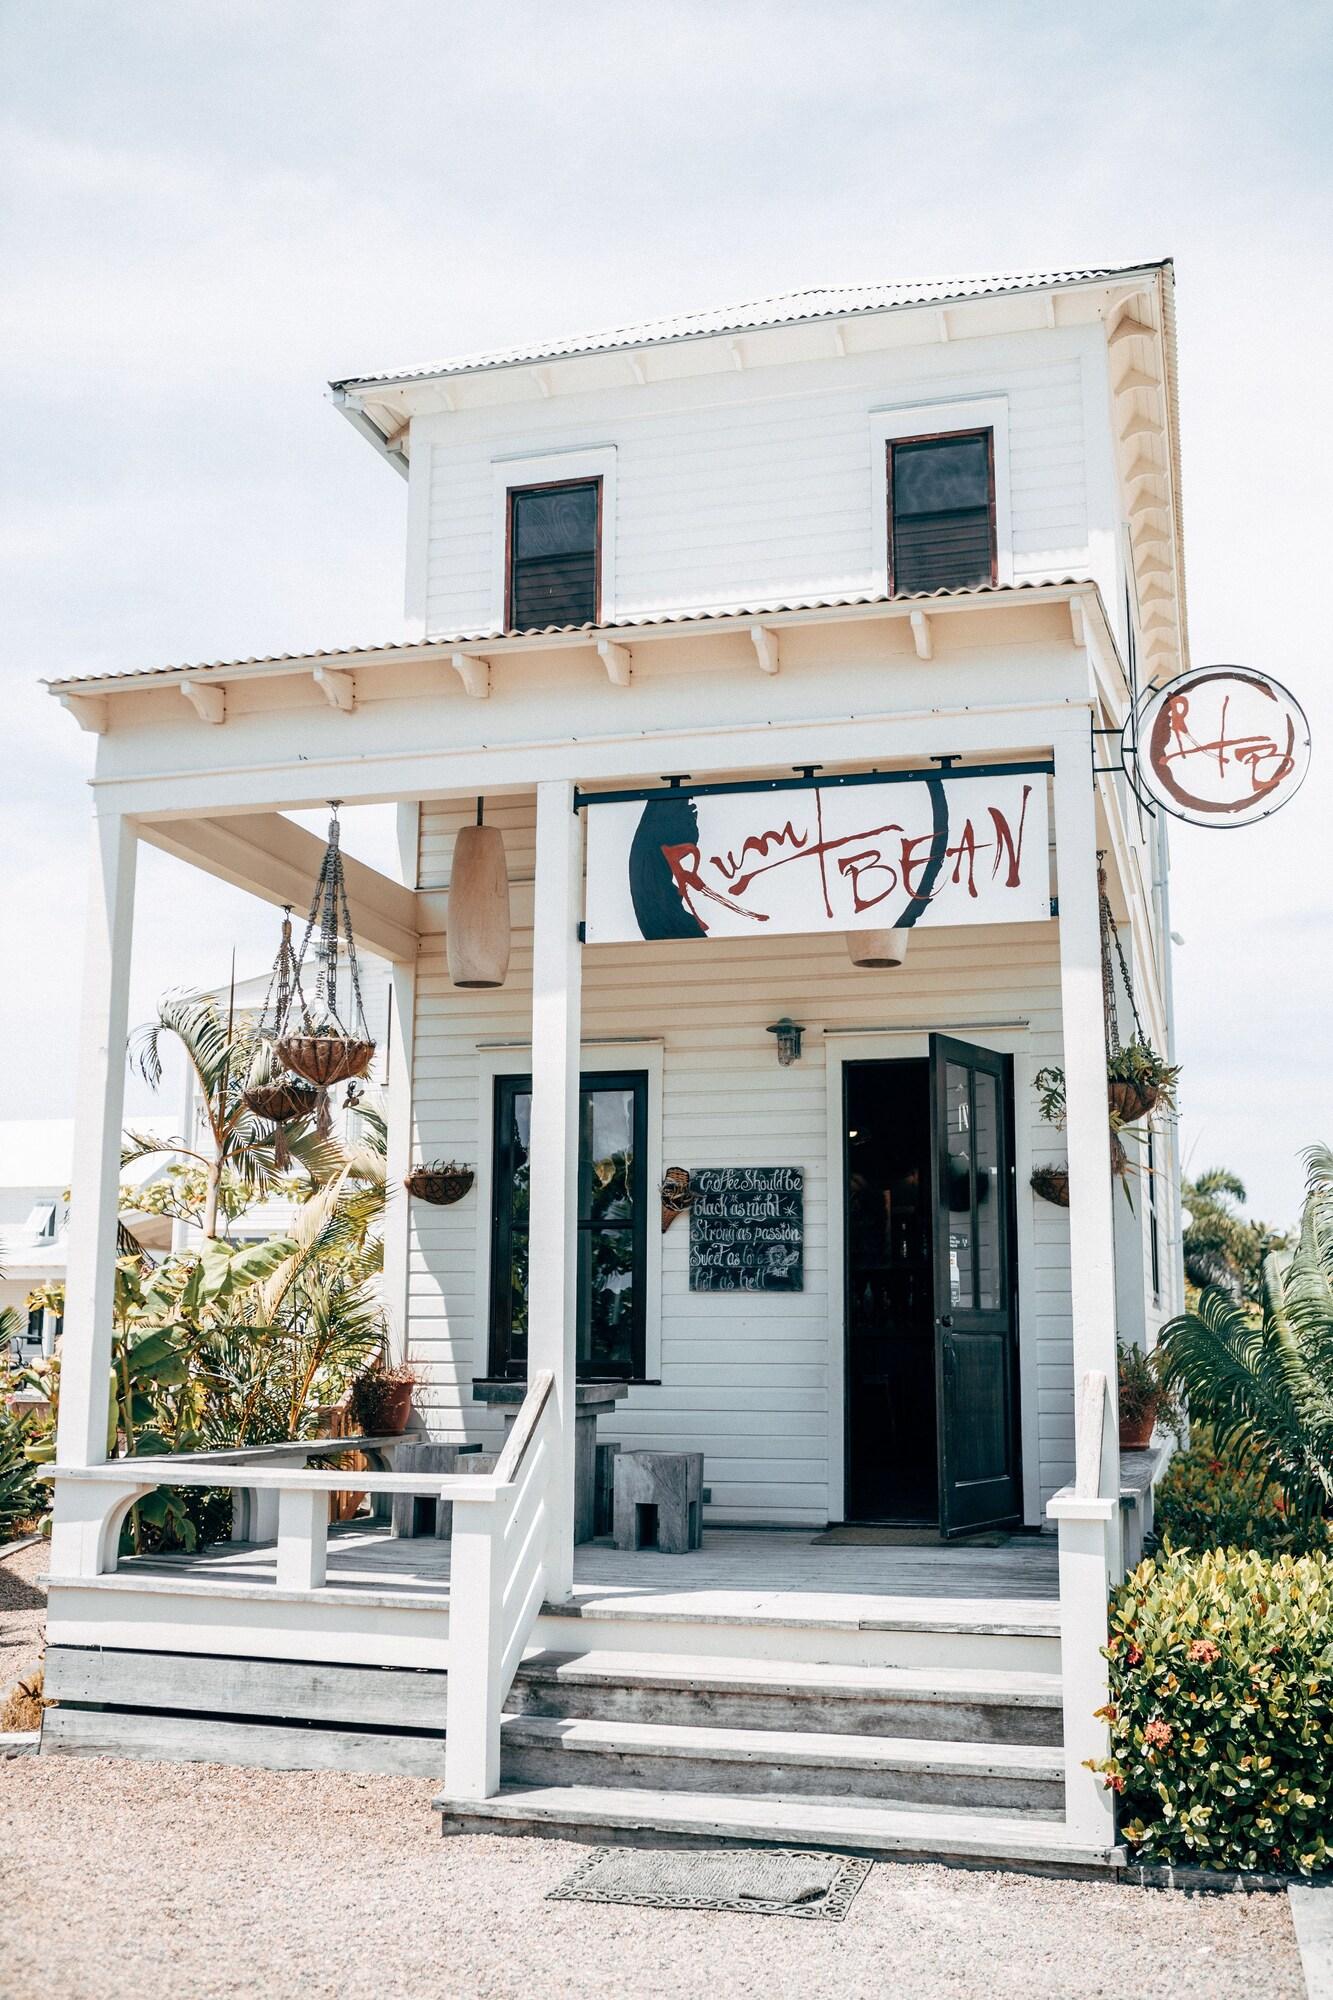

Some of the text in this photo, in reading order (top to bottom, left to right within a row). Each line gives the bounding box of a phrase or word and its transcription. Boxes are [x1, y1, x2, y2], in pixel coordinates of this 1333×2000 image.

[837, 784, 1033, 914] BEAN
[697, 1169, 803, 1192] Coffee Should be
[693, 1194, 784, 1221] black as night
[691, 1219, 801, 1246] Strong as passion
[690, 1246, 729, 1266] Sweet
[727, 1252, 740, 1266] as
